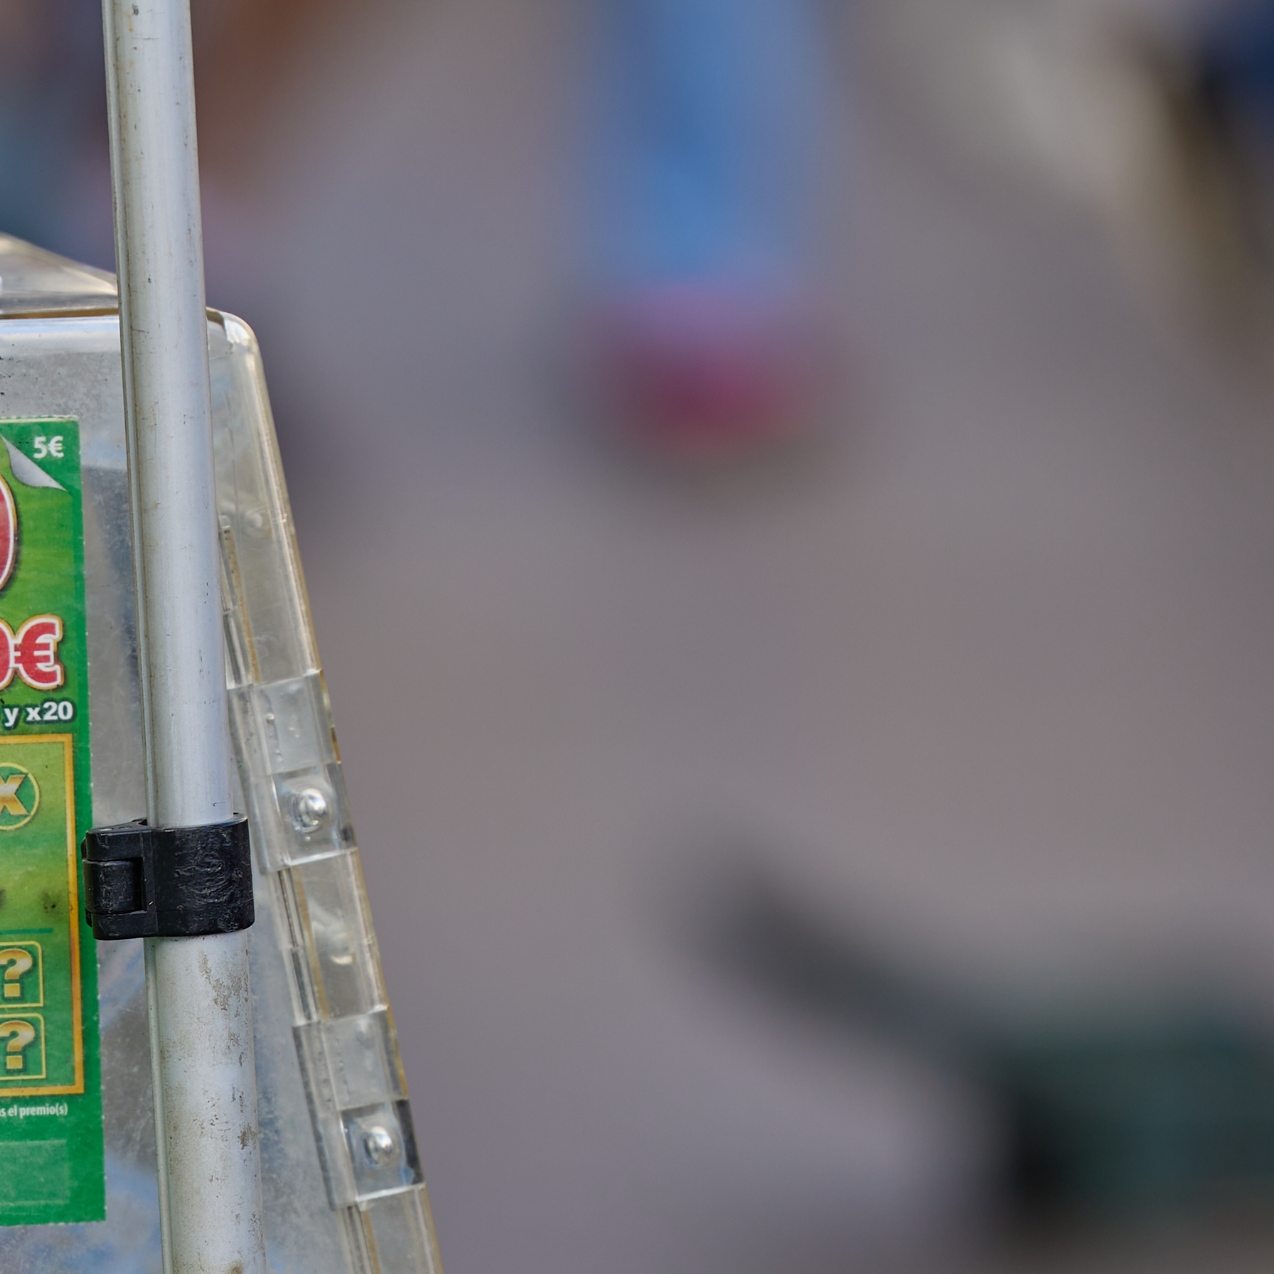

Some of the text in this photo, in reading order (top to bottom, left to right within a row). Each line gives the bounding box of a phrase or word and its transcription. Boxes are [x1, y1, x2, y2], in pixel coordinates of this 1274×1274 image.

[33, 437, 64, 459] 5€
[3, 708, 18, 729] y
[26, 701, 74, 722] x20
